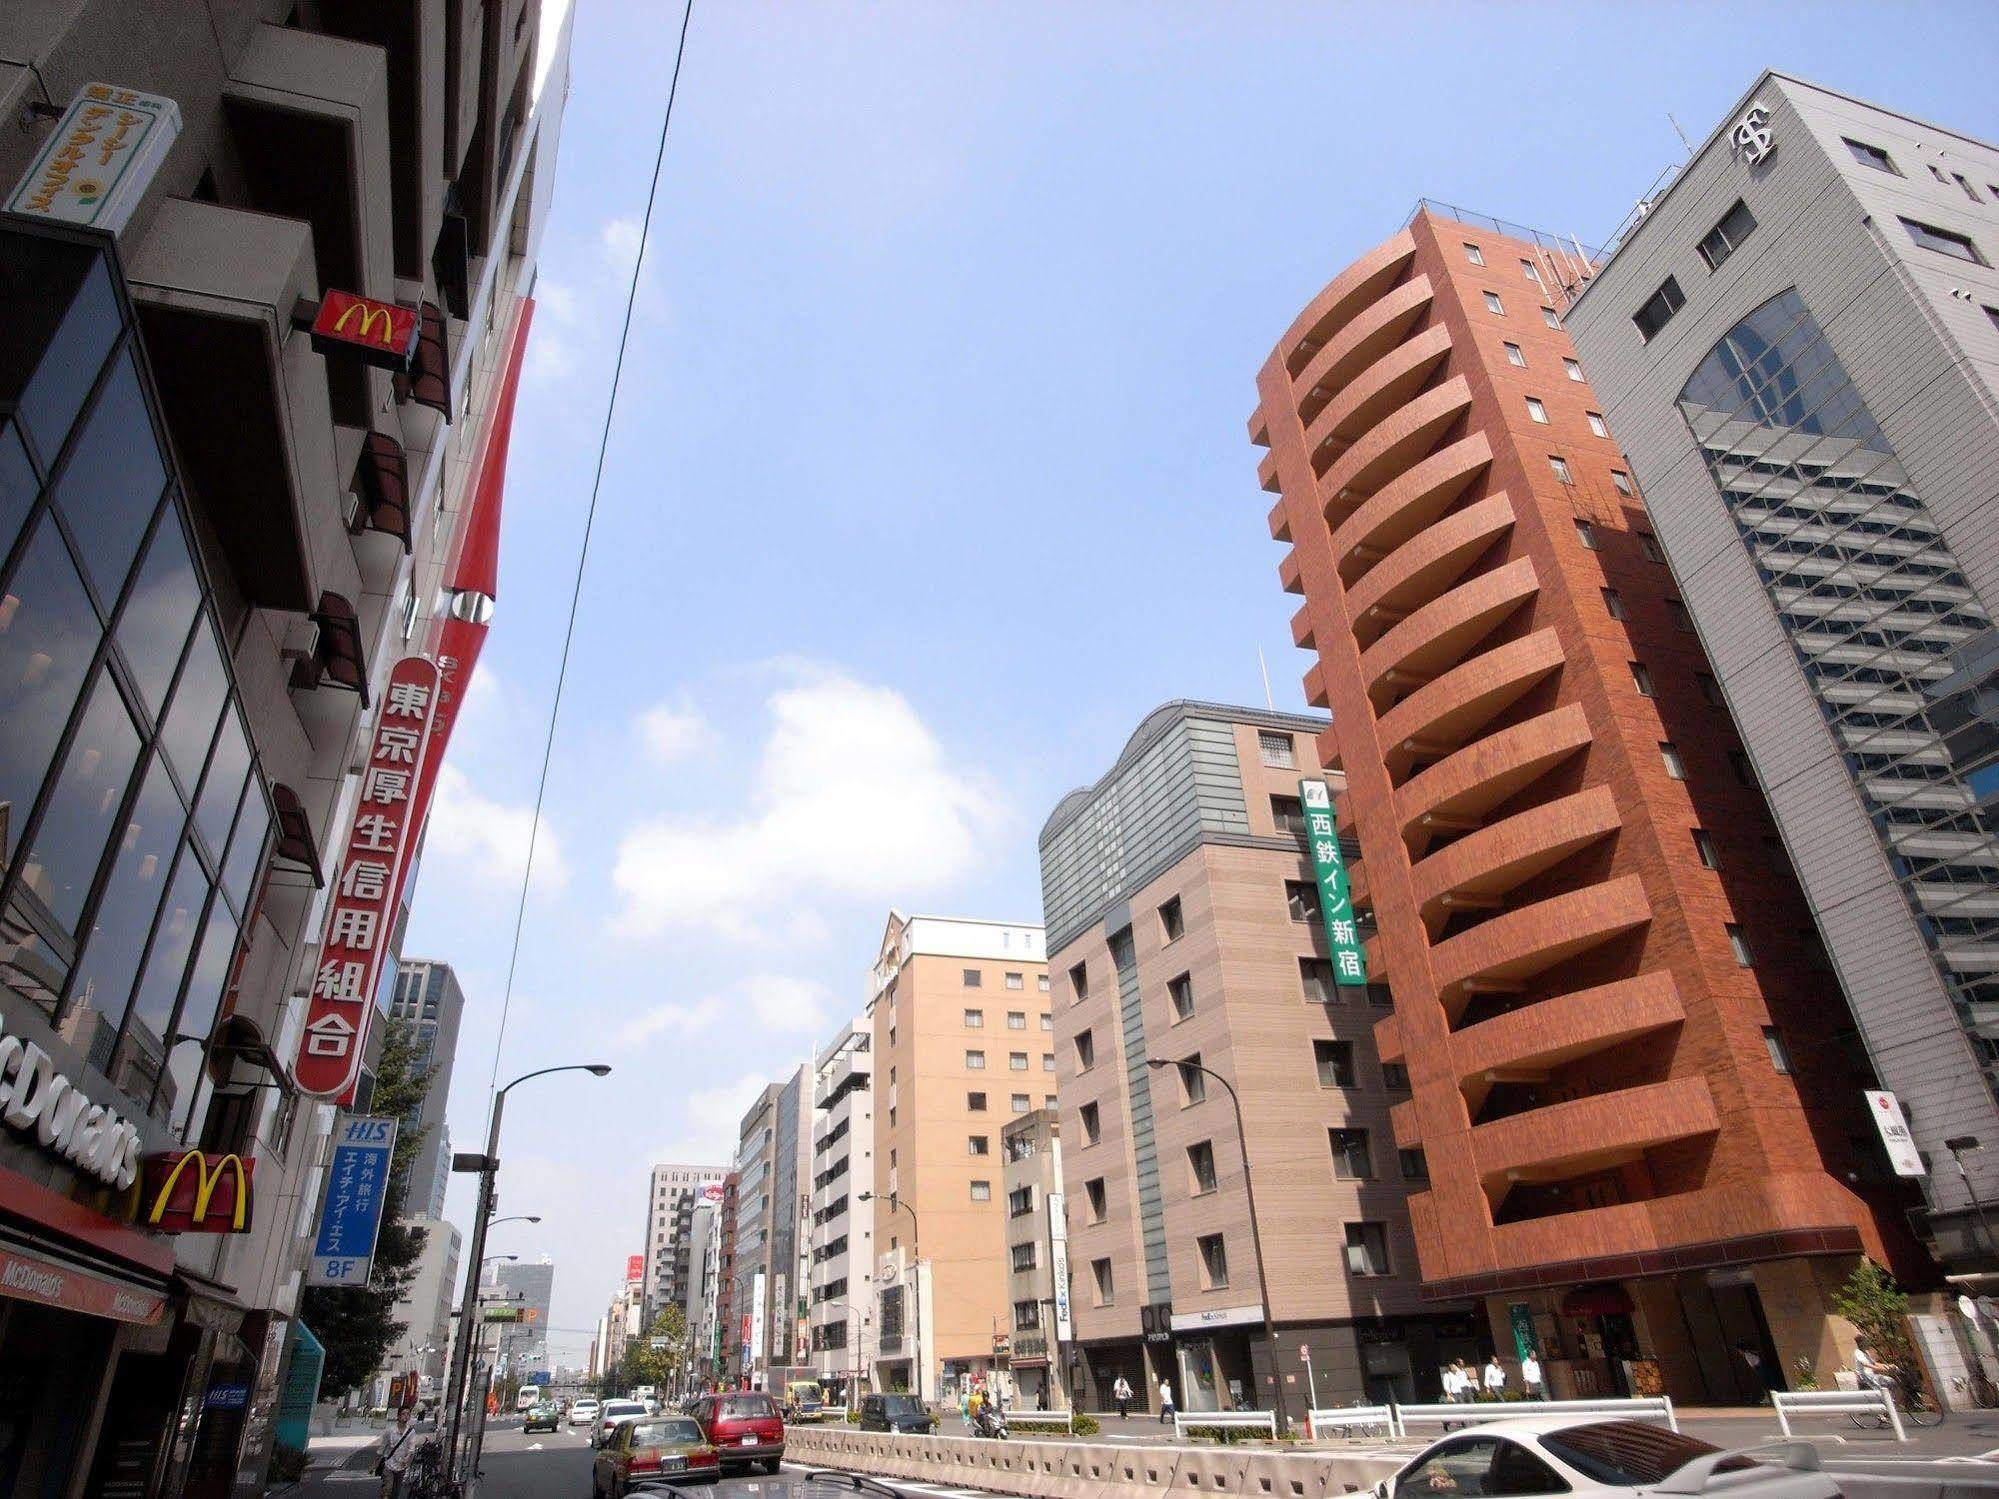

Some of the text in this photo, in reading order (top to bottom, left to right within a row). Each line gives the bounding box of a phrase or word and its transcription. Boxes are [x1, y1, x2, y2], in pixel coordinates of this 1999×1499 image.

[307, 682, 430, 1057] 東京厚生信用組合
[1310, 813, 1360, 977] 西鉄イン新宿
[355, 1153, 378, 1213] 海外旅行
[325, 1260, 355, 1278] 8F
[1058, 1290, 1069, 1322] FedEx
